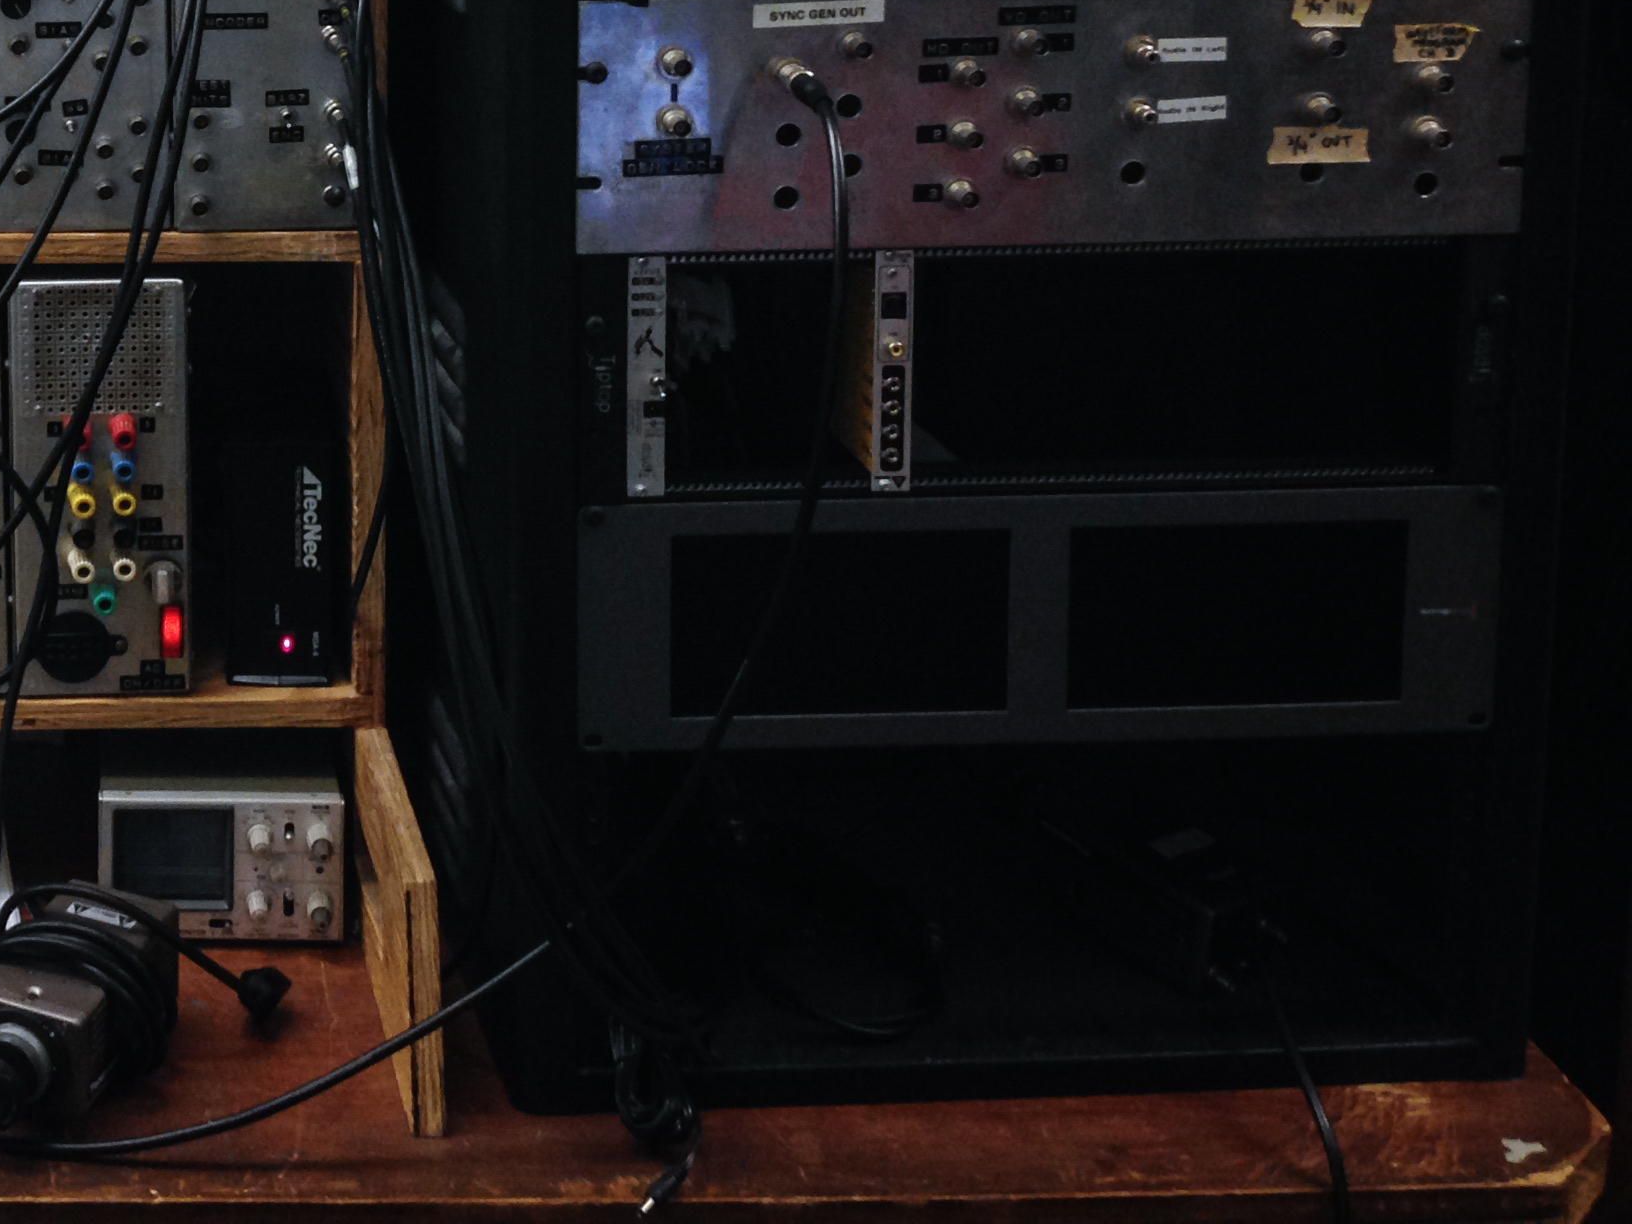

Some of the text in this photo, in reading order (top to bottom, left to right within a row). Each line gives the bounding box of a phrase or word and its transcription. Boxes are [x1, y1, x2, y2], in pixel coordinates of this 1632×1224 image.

[770, 7, 866, 22] SYNC GEN OUT
[1039, 9, 1072, 22] OUT
[1336, 0, 1356, 16] IN
[202, 16, 266, 28] NCODER
[926, 41, 995, 55] HD OUT
[1321, 134, 1354, 149] OUT
[302, 483, 323, 568] TecNec
